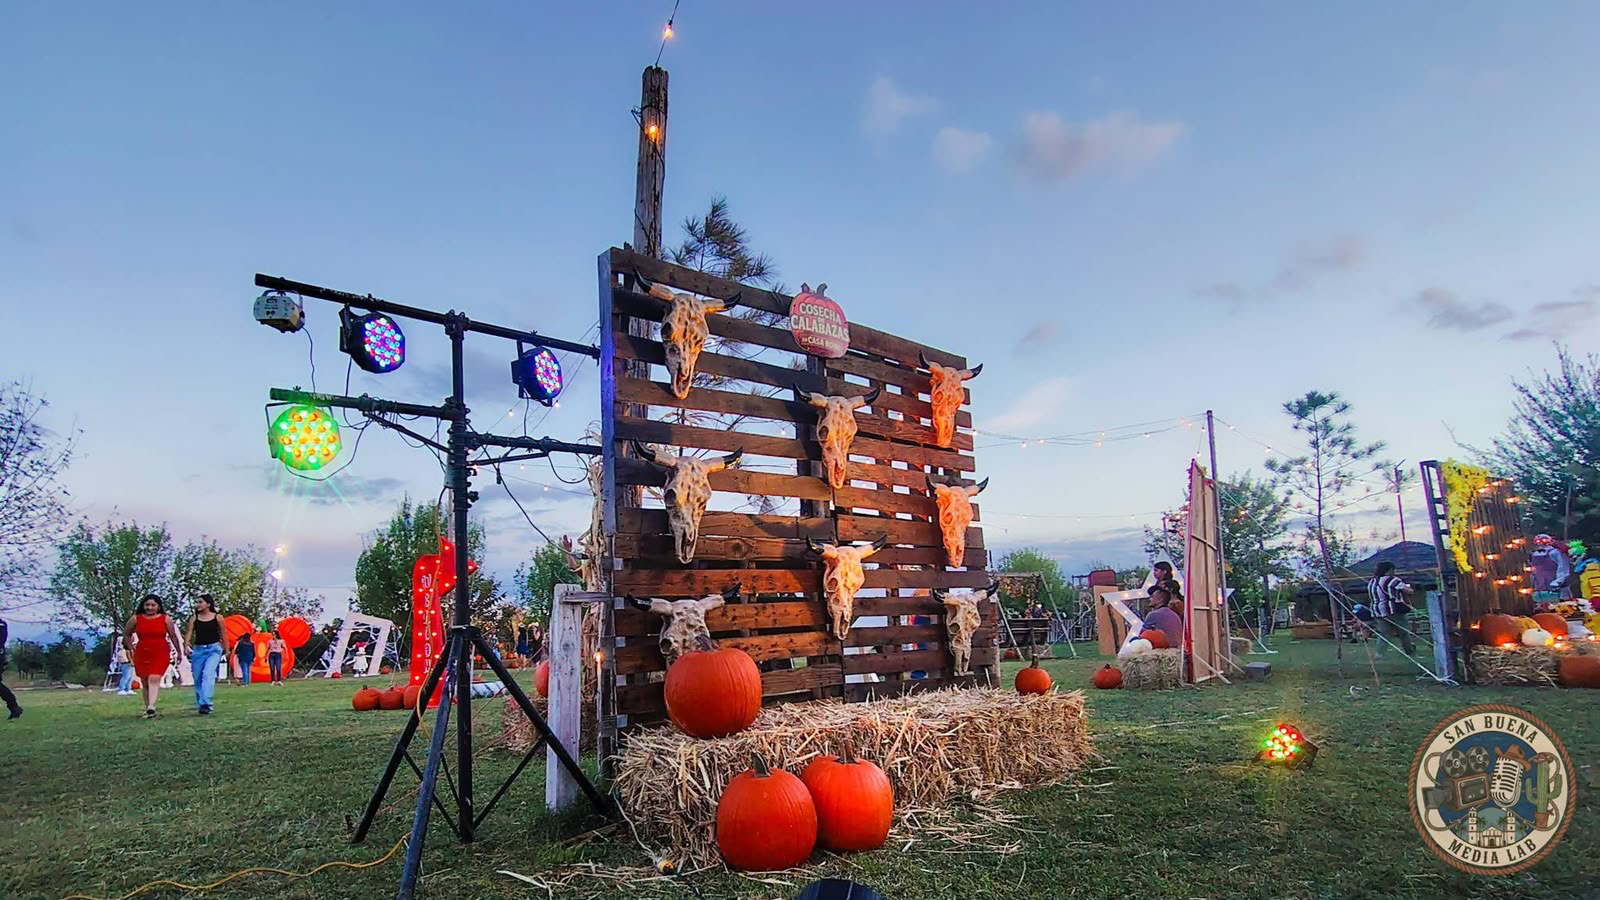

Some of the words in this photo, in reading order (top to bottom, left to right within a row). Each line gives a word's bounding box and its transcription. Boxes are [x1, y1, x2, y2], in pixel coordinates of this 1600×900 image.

[800, 303, 841, 325] COSECHA
[791, 315, 850, 342] CALABAZAS
[808, 336, 824, 347] CASA
